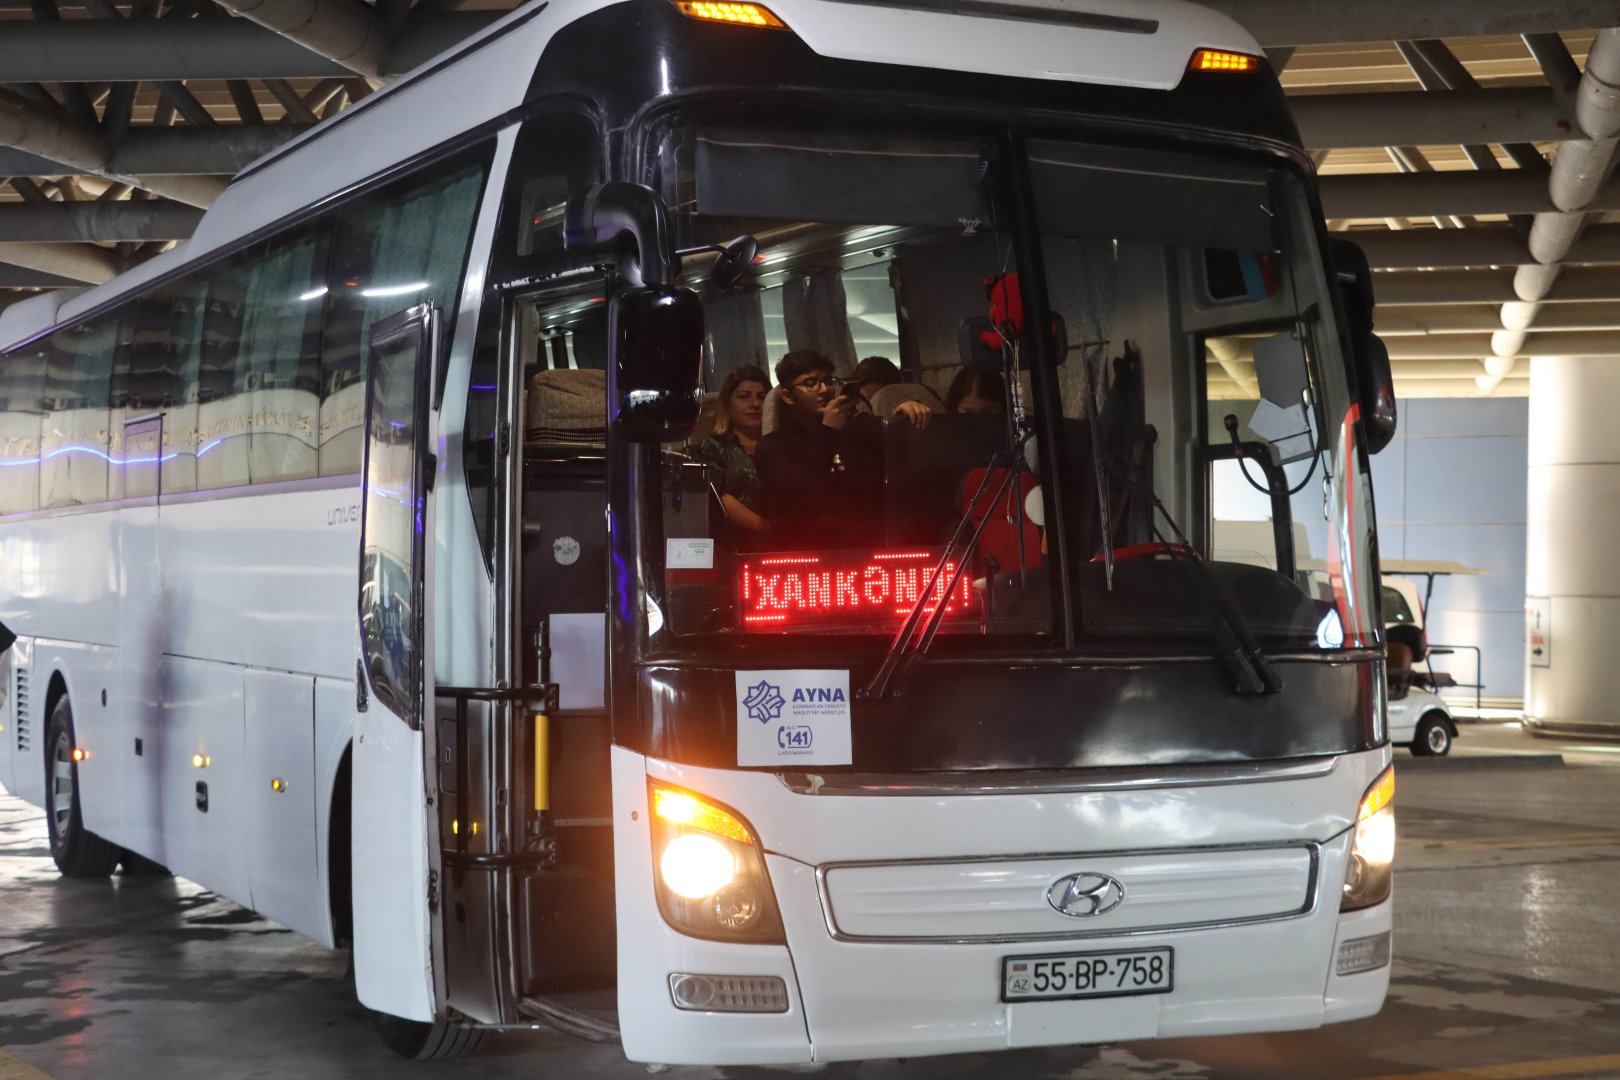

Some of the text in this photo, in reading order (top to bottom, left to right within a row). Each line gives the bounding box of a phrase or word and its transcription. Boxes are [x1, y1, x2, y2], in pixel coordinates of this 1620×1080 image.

[792, 688, 846, 702] AYNA
[785, 731, 808, 746] 141
[1033, 955, 1163, 992] 55-BP-758
[1013, 978, 1028, 990] AZ
